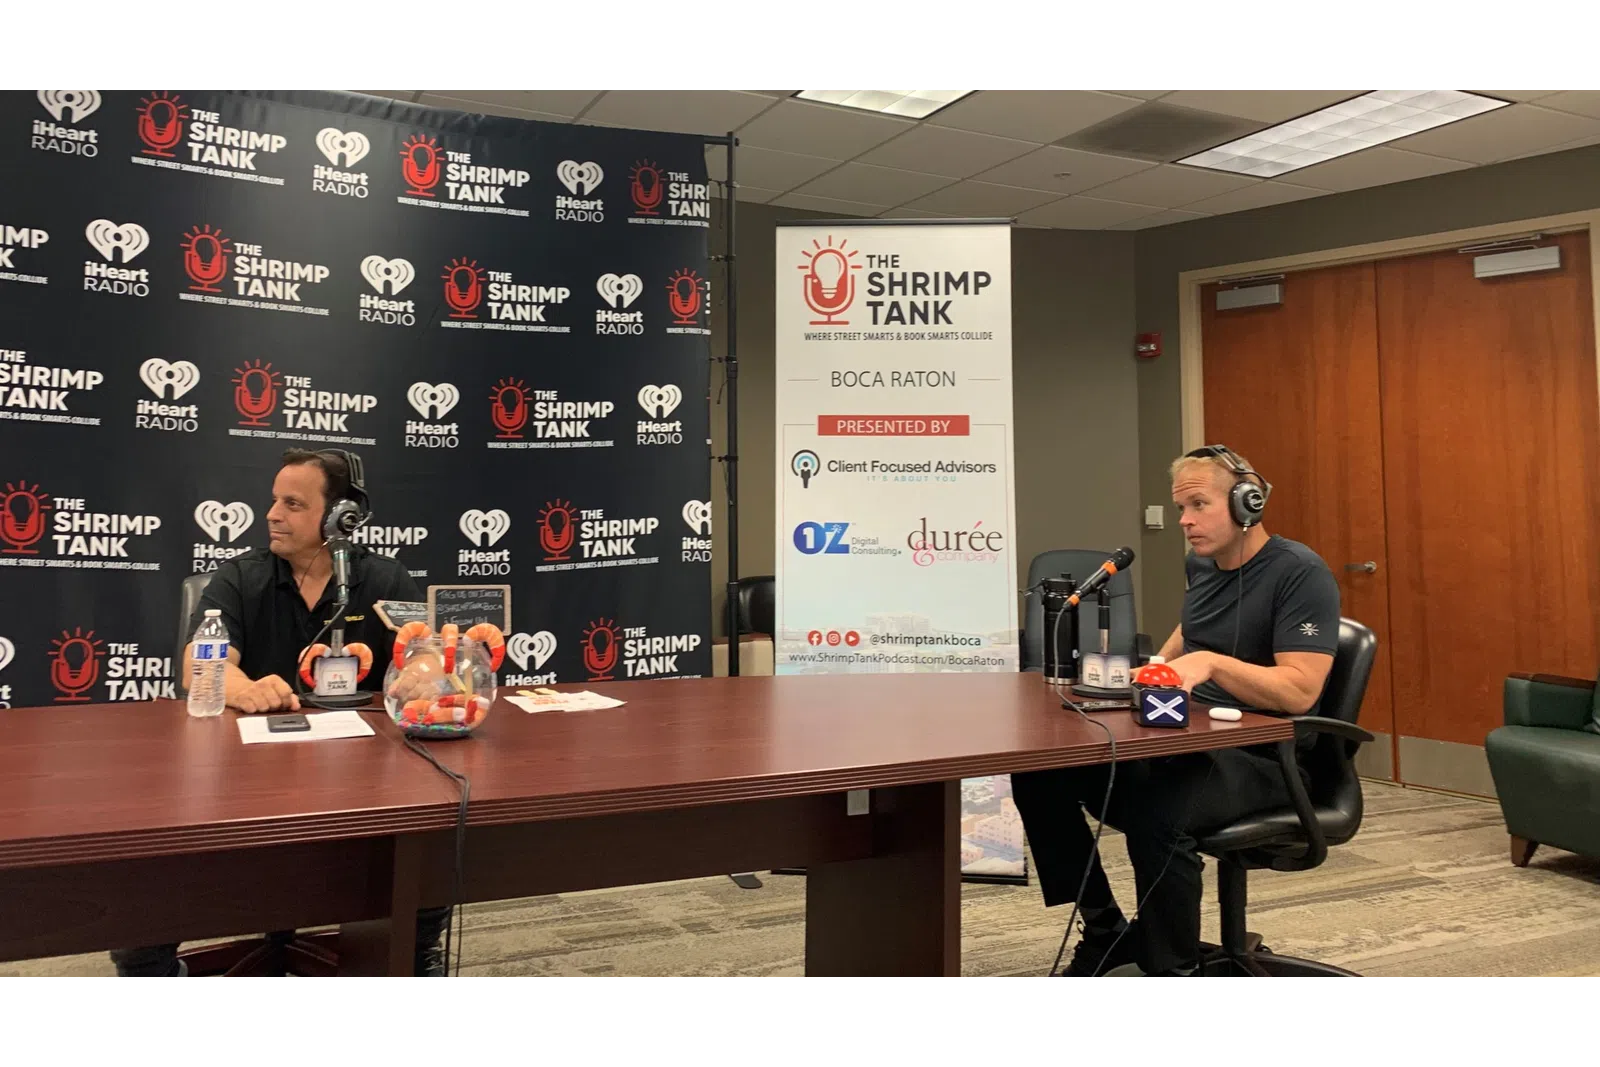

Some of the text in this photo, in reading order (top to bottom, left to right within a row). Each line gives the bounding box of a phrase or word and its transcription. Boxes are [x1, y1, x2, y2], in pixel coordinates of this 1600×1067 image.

[191, 109, 219, 124] THE
[33, 120, 98, 143] iHeart
[189, 121, 287, 153] SHRIMP
[31, 136, 98, 157] RADIO
[188, 142, 257, 171] TANK
[446, 151, 471, 164] THE
[314, 165, 368, 186] iHeart
[446, 163, 530, 187] SHRIMP
[668, 172, 689, 182] THE
[312, 179, 368, 198] RADIO
[445, 182, 504, 204] TANK
[668, 182, 710, 200] SHRI
[556, 195, 604, 211] iHeart
[668, 200, 710, 218] TAN
[555, 209, 604, 223] RADIO
[0, 224, 49, 249] IMP
[234, 242, 262, 256] THE
[233, 256, 330, 284] SHRIMP
[866, 254, 900, 269] THE
[84, 261, 149, 283] iHeart
[488, 271, 512, 283] THE
[84, 277, 150, 297] RADIO
[233, 276, 301, 302] TANK
[867, 271, 992, 296] SHRIMP
[488, 284, 570, 304] SHRIMP
[359, 294, 415, 313] iHeart
[488, 303, 546, 322] TANK
[866, 300, 954, 325] TANK
[359, 309, 415, 327] RADIO
[596, 310, 643, 323] iHeart
[596, 323, 644, 335] RADIO
[804, 332, 993, 341] WHERE STREET SMARTS & BOOK SMARTS COLLIDE
[0, 362, 104, 391] SHRIMP
[284, 375, 311, 388] THE
[831, 370, 956, 388] BOCA RATON
[284, 388, 377, 414] SHRIMP
[534, 390, 558, 401] THE
[137, 399, 198, 419] iHeart
[534, 401, 615, 419] SHRIMP
[135, 415, 199, 433] RADIO
[283, 409, 348, 433] TANK
[406, 420, 459, 435] iHeart
[533, 420, 590, 439] TANK
[637, 420, 682, 433] iHeart
[837, 420, 951, 434] PRESENTED BY
[405, 435, 459, 448] RADIO
[637, 433, 683, 445] RADIO
[827, 460, 997, 473] Client Focused Advisors
[53, 497, 85, 510] THE
[580, 509, 604, 520] THE
[53, 512, 161, 536] SHRIMP
[580, 517, 659, 539] SHRIMP
[349, 526, 428, 545] HRIMP
[682, 537, 712, 549] iHea
[851, 537, 879, 547] Digital
[907, 517, 1003, 552] durée
[52, 534, 129, 557] TANK
[579, 538, 636, 559] TANK
[458, 549, 510, 563] iHeart
[682, 550, 712, 562] RAD
[936, 551, 999, 564] company
[458, 562, 510, 576] RADIO
[623, 626, 646, 639] THE
[870, 633, 981, 647] @shrimptankboca
[107, 643, 139, 656] THE
[624, 634, 701, 658] SHRIMP
[107, 657, 174, 677] SHRI
[623, 655, 678, 677] TANK
[789, 652, 1005, 666] www.ShrimpTankPodcast.com/BocaRaton
[505, 671, 556, 686] iHeart
[105, 680, 176, 701] TANK
